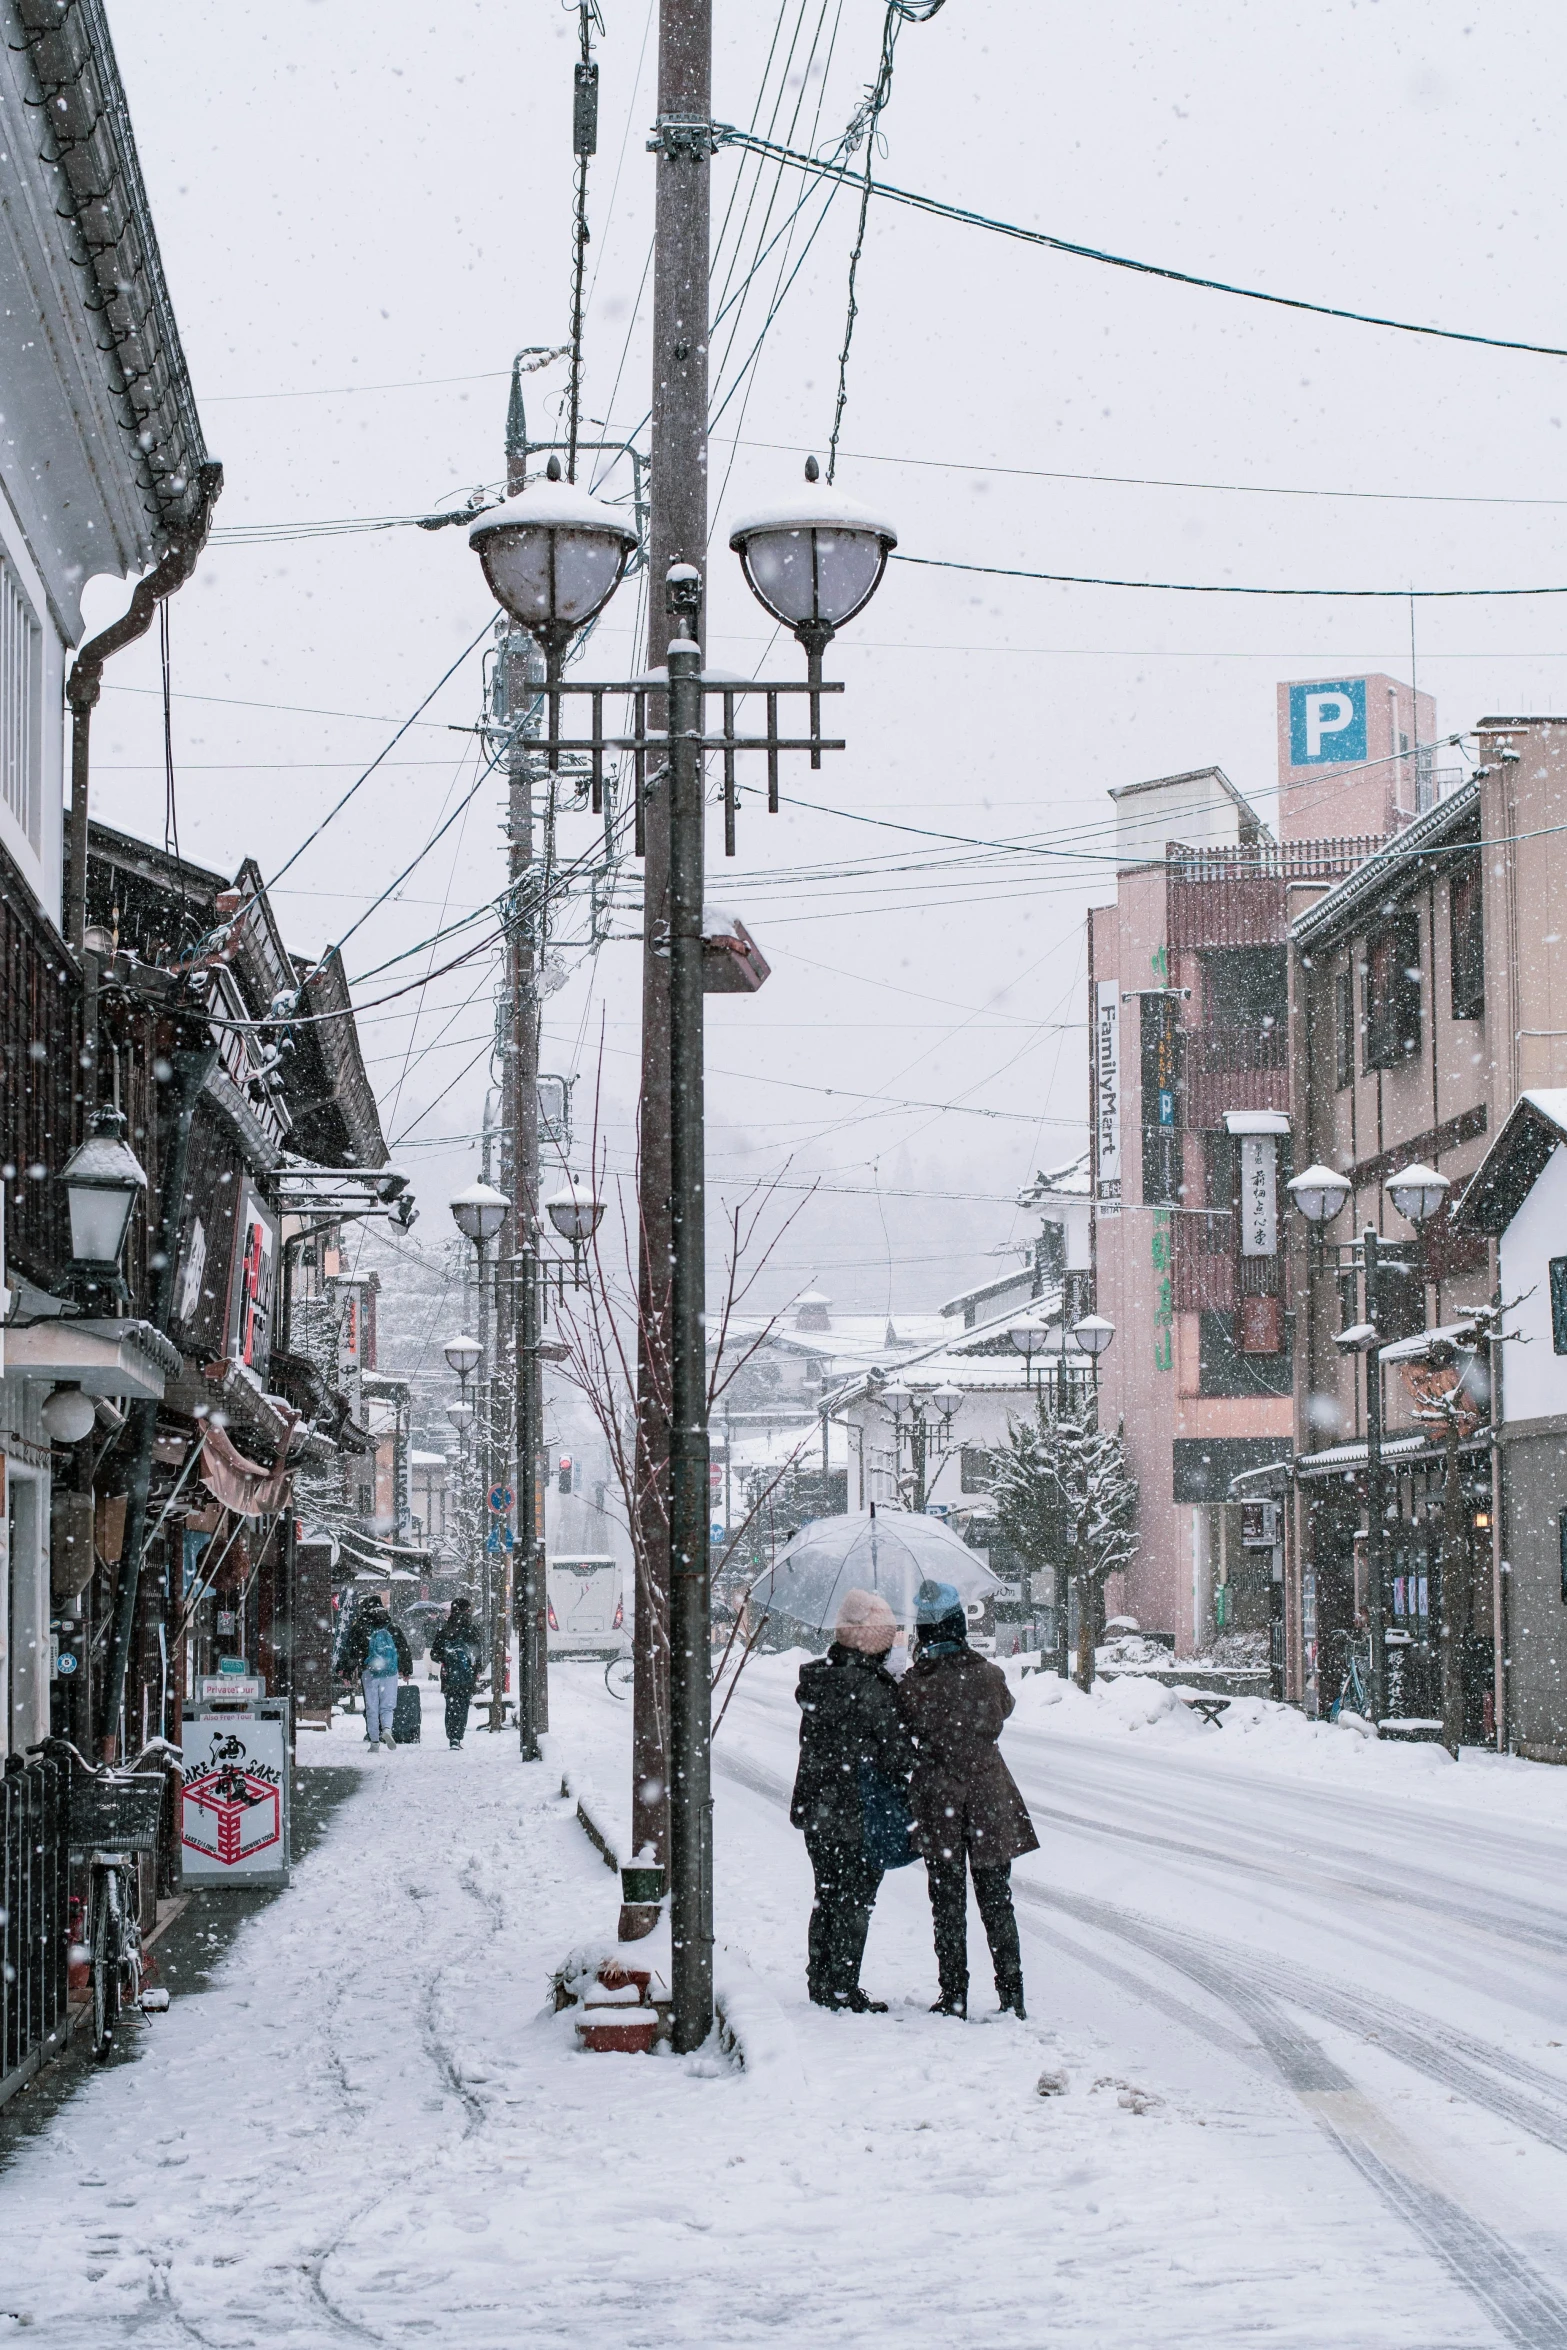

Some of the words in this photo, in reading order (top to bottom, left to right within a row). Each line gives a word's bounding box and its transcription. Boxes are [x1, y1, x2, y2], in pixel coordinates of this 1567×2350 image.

[1306, 692, 1353, 756] P
[1099, 1004, 1117, 1156] FamilyMart
[1162, 1095, 1171, 1121] P
[245, 1759, 282, 1785] SAKE
